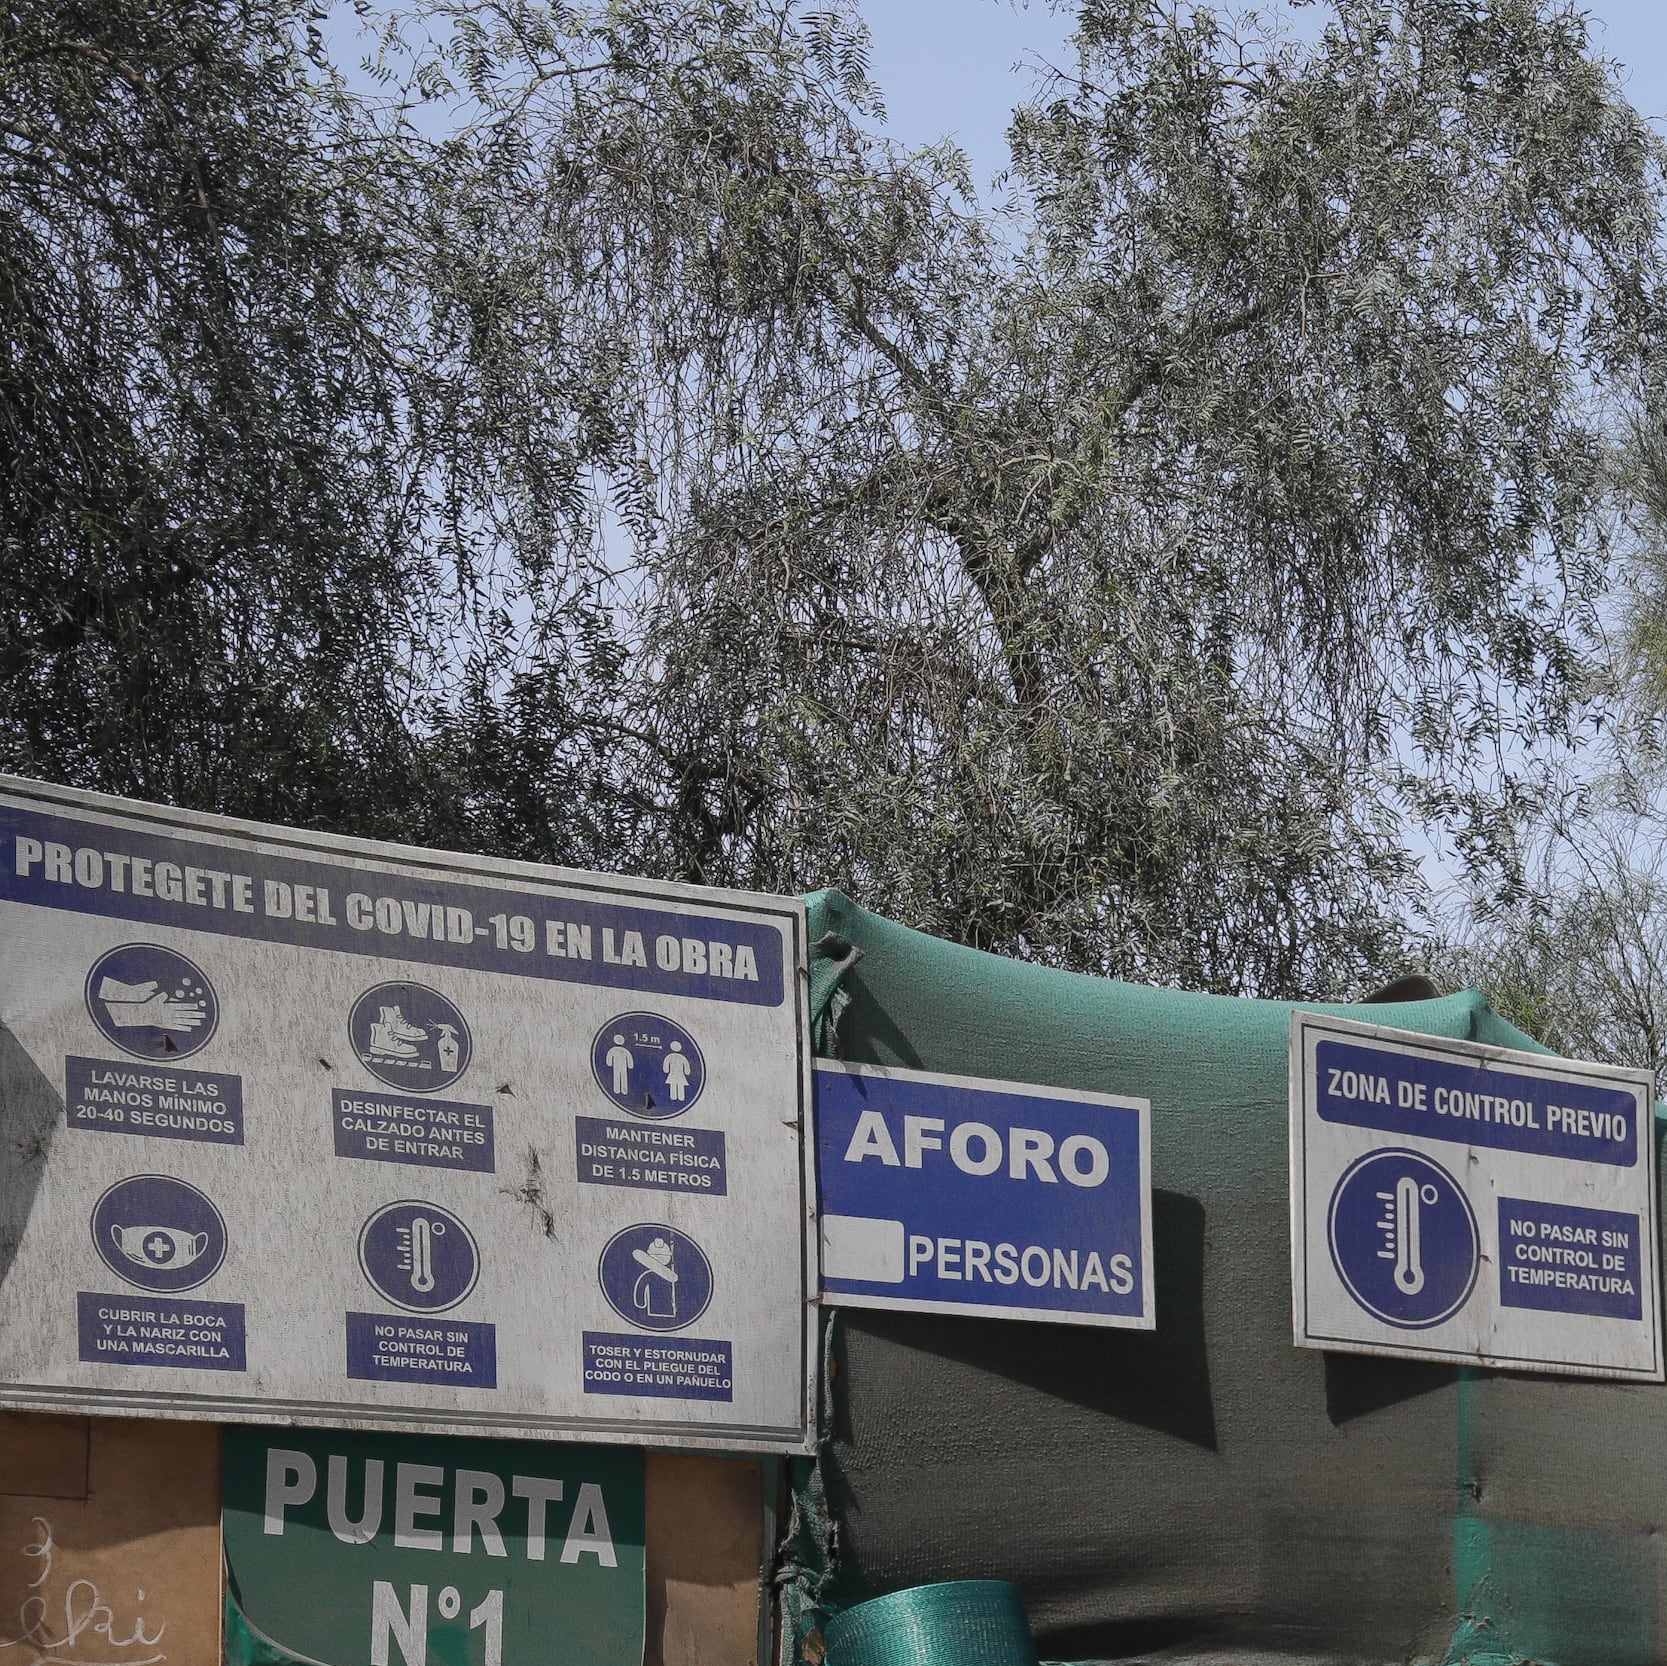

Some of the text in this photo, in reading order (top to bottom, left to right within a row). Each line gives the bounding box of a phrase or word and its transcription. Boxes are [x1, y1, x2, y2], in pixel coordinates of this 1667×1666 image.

[16, 836, 759, 981] PROTEGETE DEL COVID-19 EN LA OBRA
[633, 1032, 648, 1042] 1.5
[92, 1070, 218, 1096] LAVARSE LAS
[83, 1088, 227, 1115] MANOS MÍNIMO
[341, 1100, 485, 1128] DESINFECTAR EL
[1328, 1069, 1626, 1142] ZONA DE CONTROL PREVIO
[77, 1105, 235, 1133] 20-40 SEGUNDOS
[342, 1118, 485, 1144] CALZADO ANTES
[366, 1137, 464, 1159] DE ENTRAR
[606, 1127, 695, 1148] MANTENER
[844, 1111, 1109, 1187] AFORO
[582, 1144, 721, 1169] DISTANCIA FÍSICA
[592, 1164, 712, 1187] DE 1.5 METROS
[1511, 1220, 1628, 1249] NO PASAR SIN
[910, 1236, 1134, 1294] PERSONAS
[1516, 1244, 1625, 1271] CONTROL DE
[1508, 1266, 1635, 1295] TEMPERATURA
[99, 1308, 226, 1328] CUBRIR LA BOCA
[104, 1324, 221, 1342] Y LA NARIZ CON
[375, 1326, 468, 1343] NO PASAR SIN
[97, 1340, 230, 1358] UNA MASCARILLA
[379, 1341, 465, 1357] CONTROL DE
[590, 1346, 726, 1363] TOSER Y ESTORNUDAR
[372, 1355, 473, 1373] TEMPERATURA
[596, 1358, 720, 1375] CON EL PLIEGUE DEL
[585, 1370, 731, 1388] CODO O EN UN PAÑUELO
[264, 1448, 618, 1568] PUERTA
